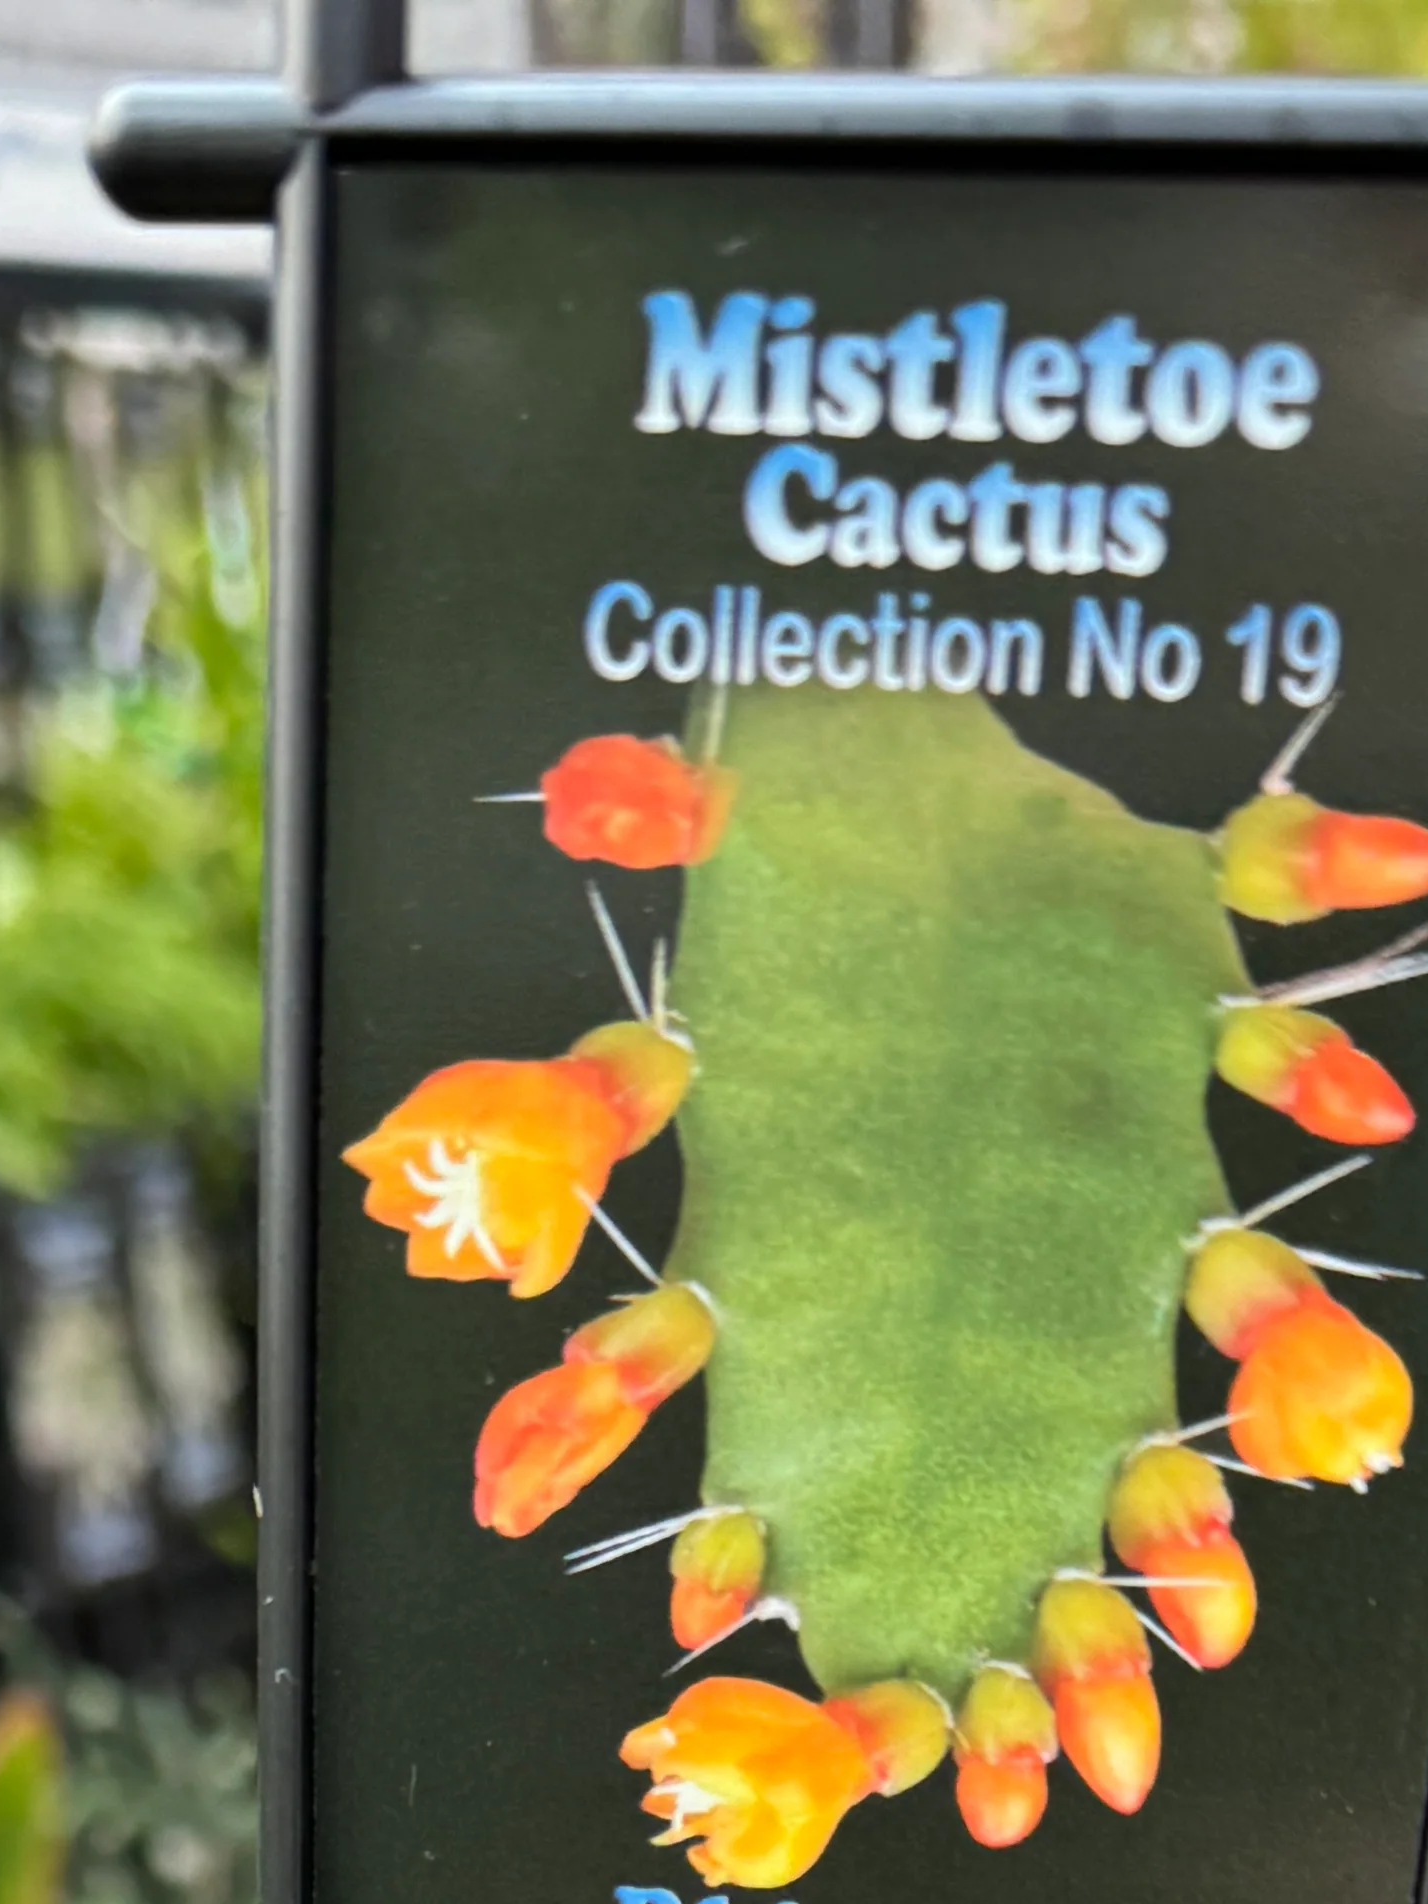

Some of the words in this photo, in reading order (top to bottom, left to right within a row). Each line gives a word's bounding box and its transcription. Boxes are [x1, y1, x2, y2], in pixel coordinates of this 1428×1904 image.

[634, 289, 1320, 451] Mistletoe
[744, 444, 1169, 577] Cactus
[585, 580, 1044, 695] Collection
[1067, 595, 1202, 702] No
[1227, 603, 1342, 706] 19
